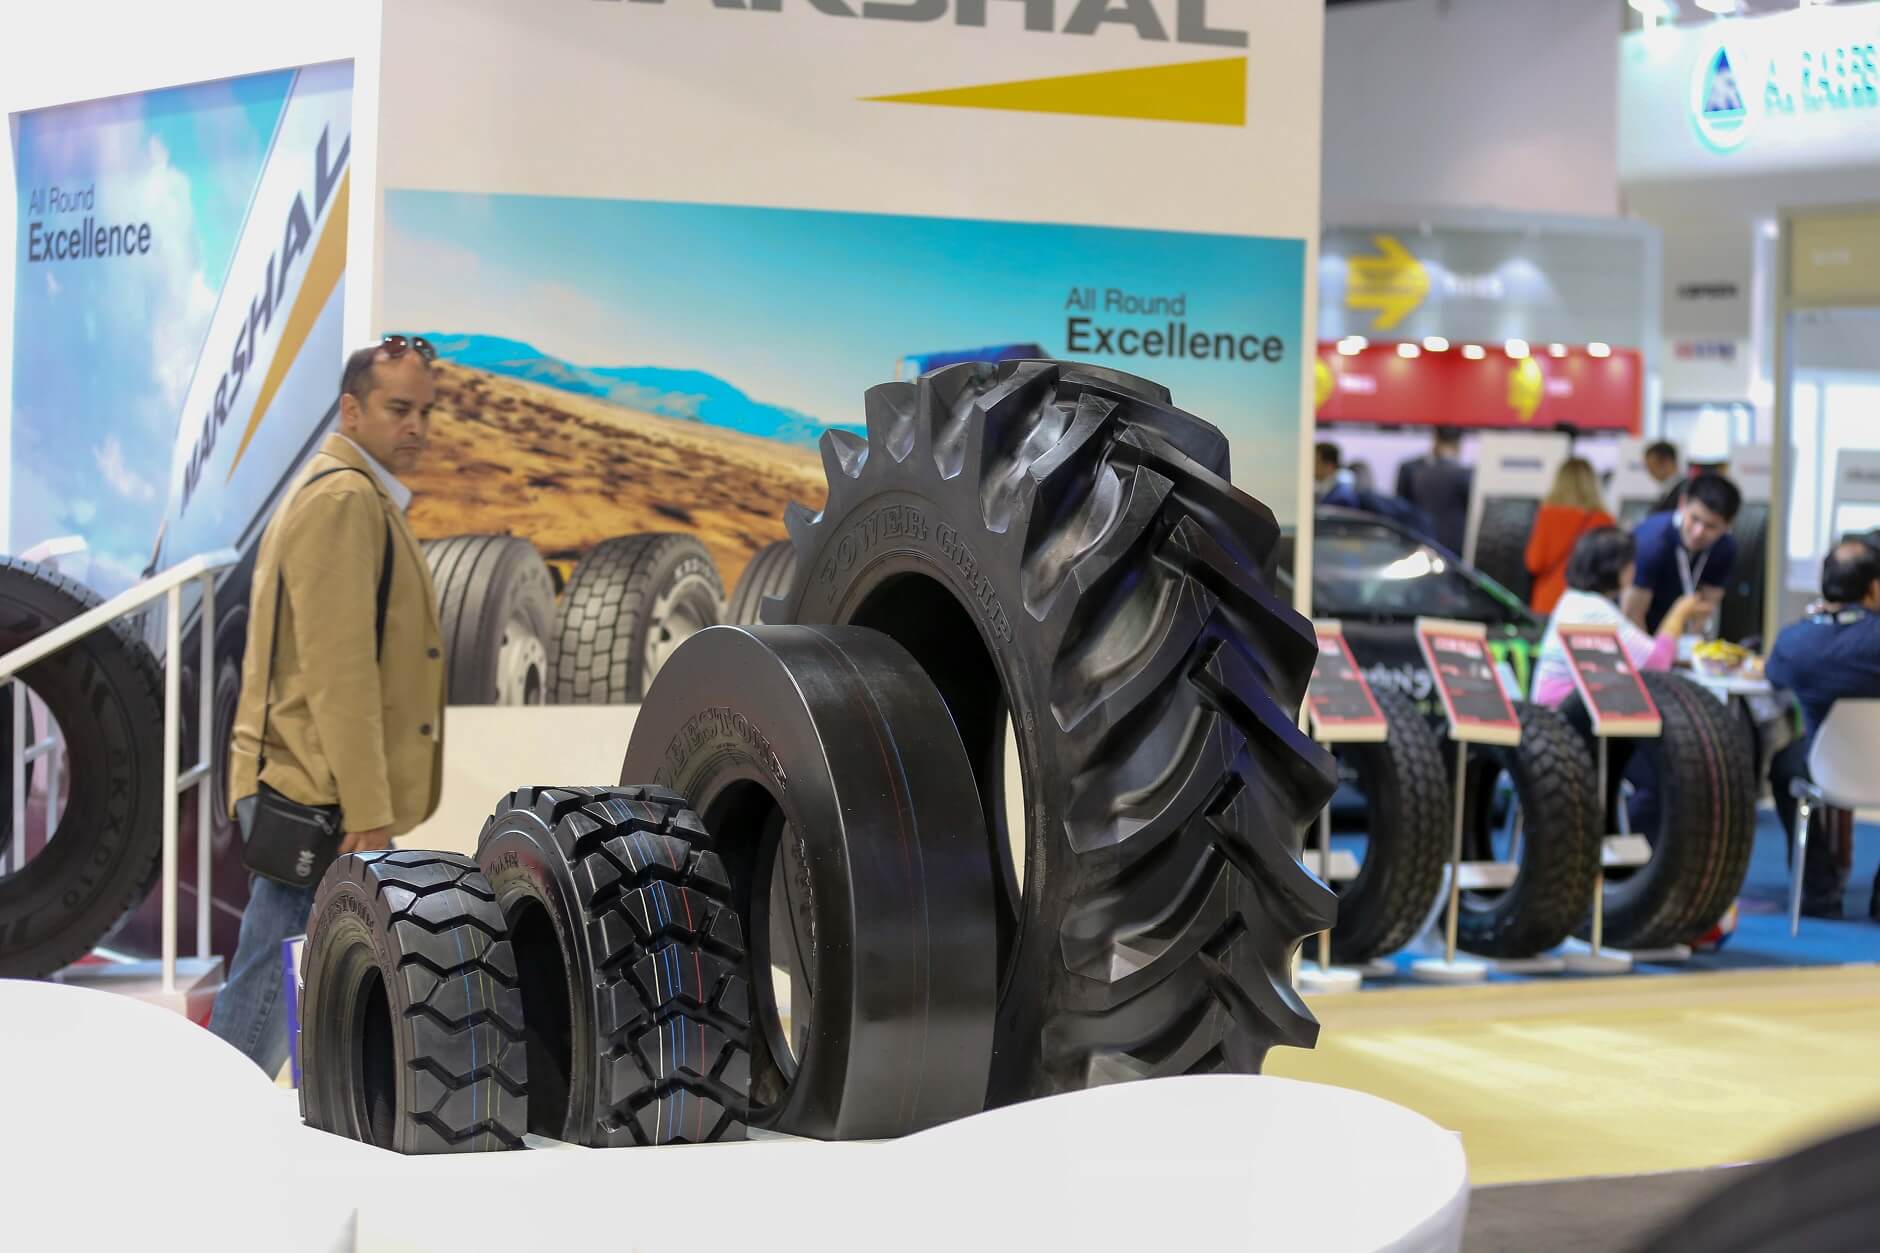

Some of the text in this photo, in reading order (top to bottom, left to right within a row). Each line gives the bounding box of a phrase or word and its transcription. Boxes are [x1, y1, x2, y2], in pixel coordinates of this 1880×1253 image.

[28, 184, 95, 216] All Round
[29, 217, 151, 262] Excellence
[1066, 287, 1186, 317] All Round
[1067, 317, 1284, 363] Excellence
[820, 504, 1012, 643] POWER GRIP
